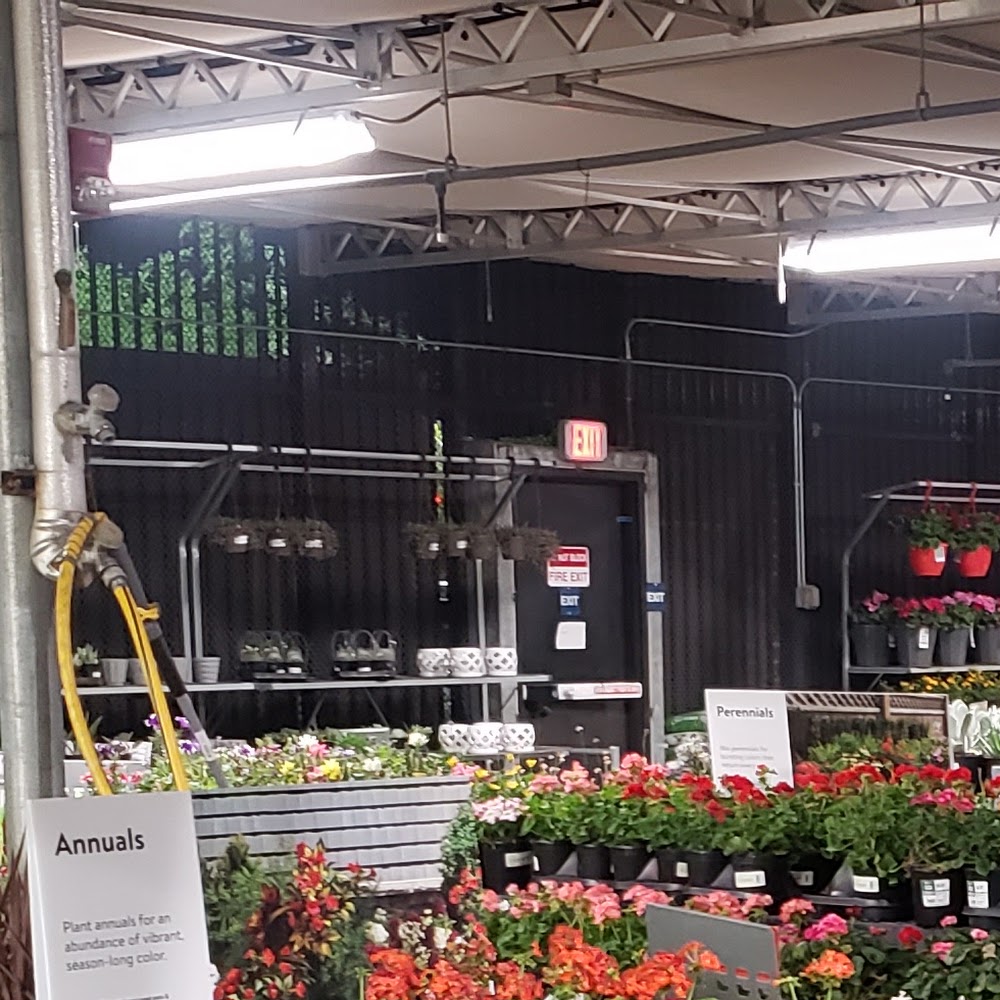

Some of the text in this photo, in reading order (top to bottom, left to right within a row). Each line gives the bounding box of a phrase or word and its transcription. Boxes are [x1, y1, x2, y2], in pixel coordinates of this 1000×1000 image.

[573, 425, 602, 458] EXIT
[550, 571, 588, 582] FIRE EXIT
[560, 595, 580, 606] EXIT
[646, 592, 665, 603] EXIT
[717, 705, 774, 718] Perennials
[55, 827, 145, 856] Annuals
[62, 913, 171, 933] Plant annuals for an
[65, 937, 126, 952] abundance
[128, 932, 141, 946] of
[66, 954, 134, 972] season-long
